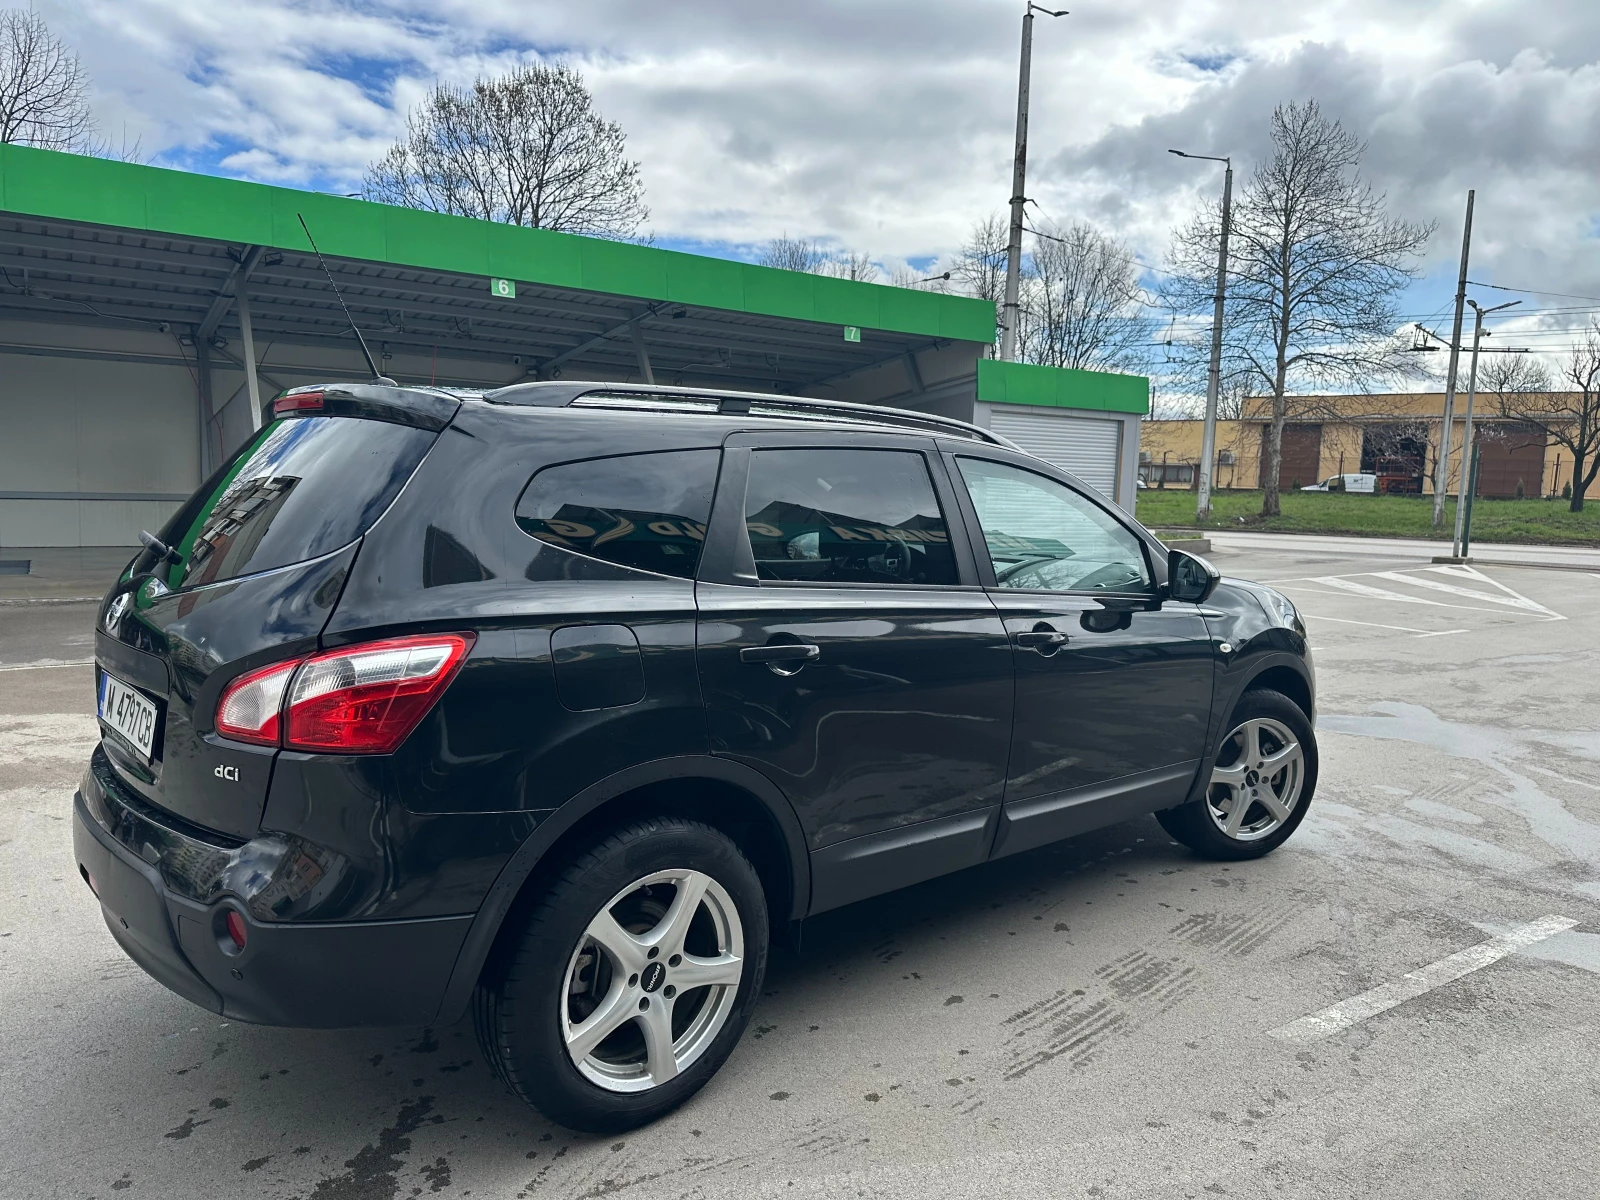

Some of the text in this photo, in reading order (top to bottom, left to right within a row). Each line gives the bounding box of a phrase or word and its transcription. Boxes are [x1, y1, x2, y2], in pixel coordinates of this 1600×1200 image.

[499, 279, 509, 294] 6
[849, 326, 857, 340] 7
[214, 764, 239, 781] dCi
